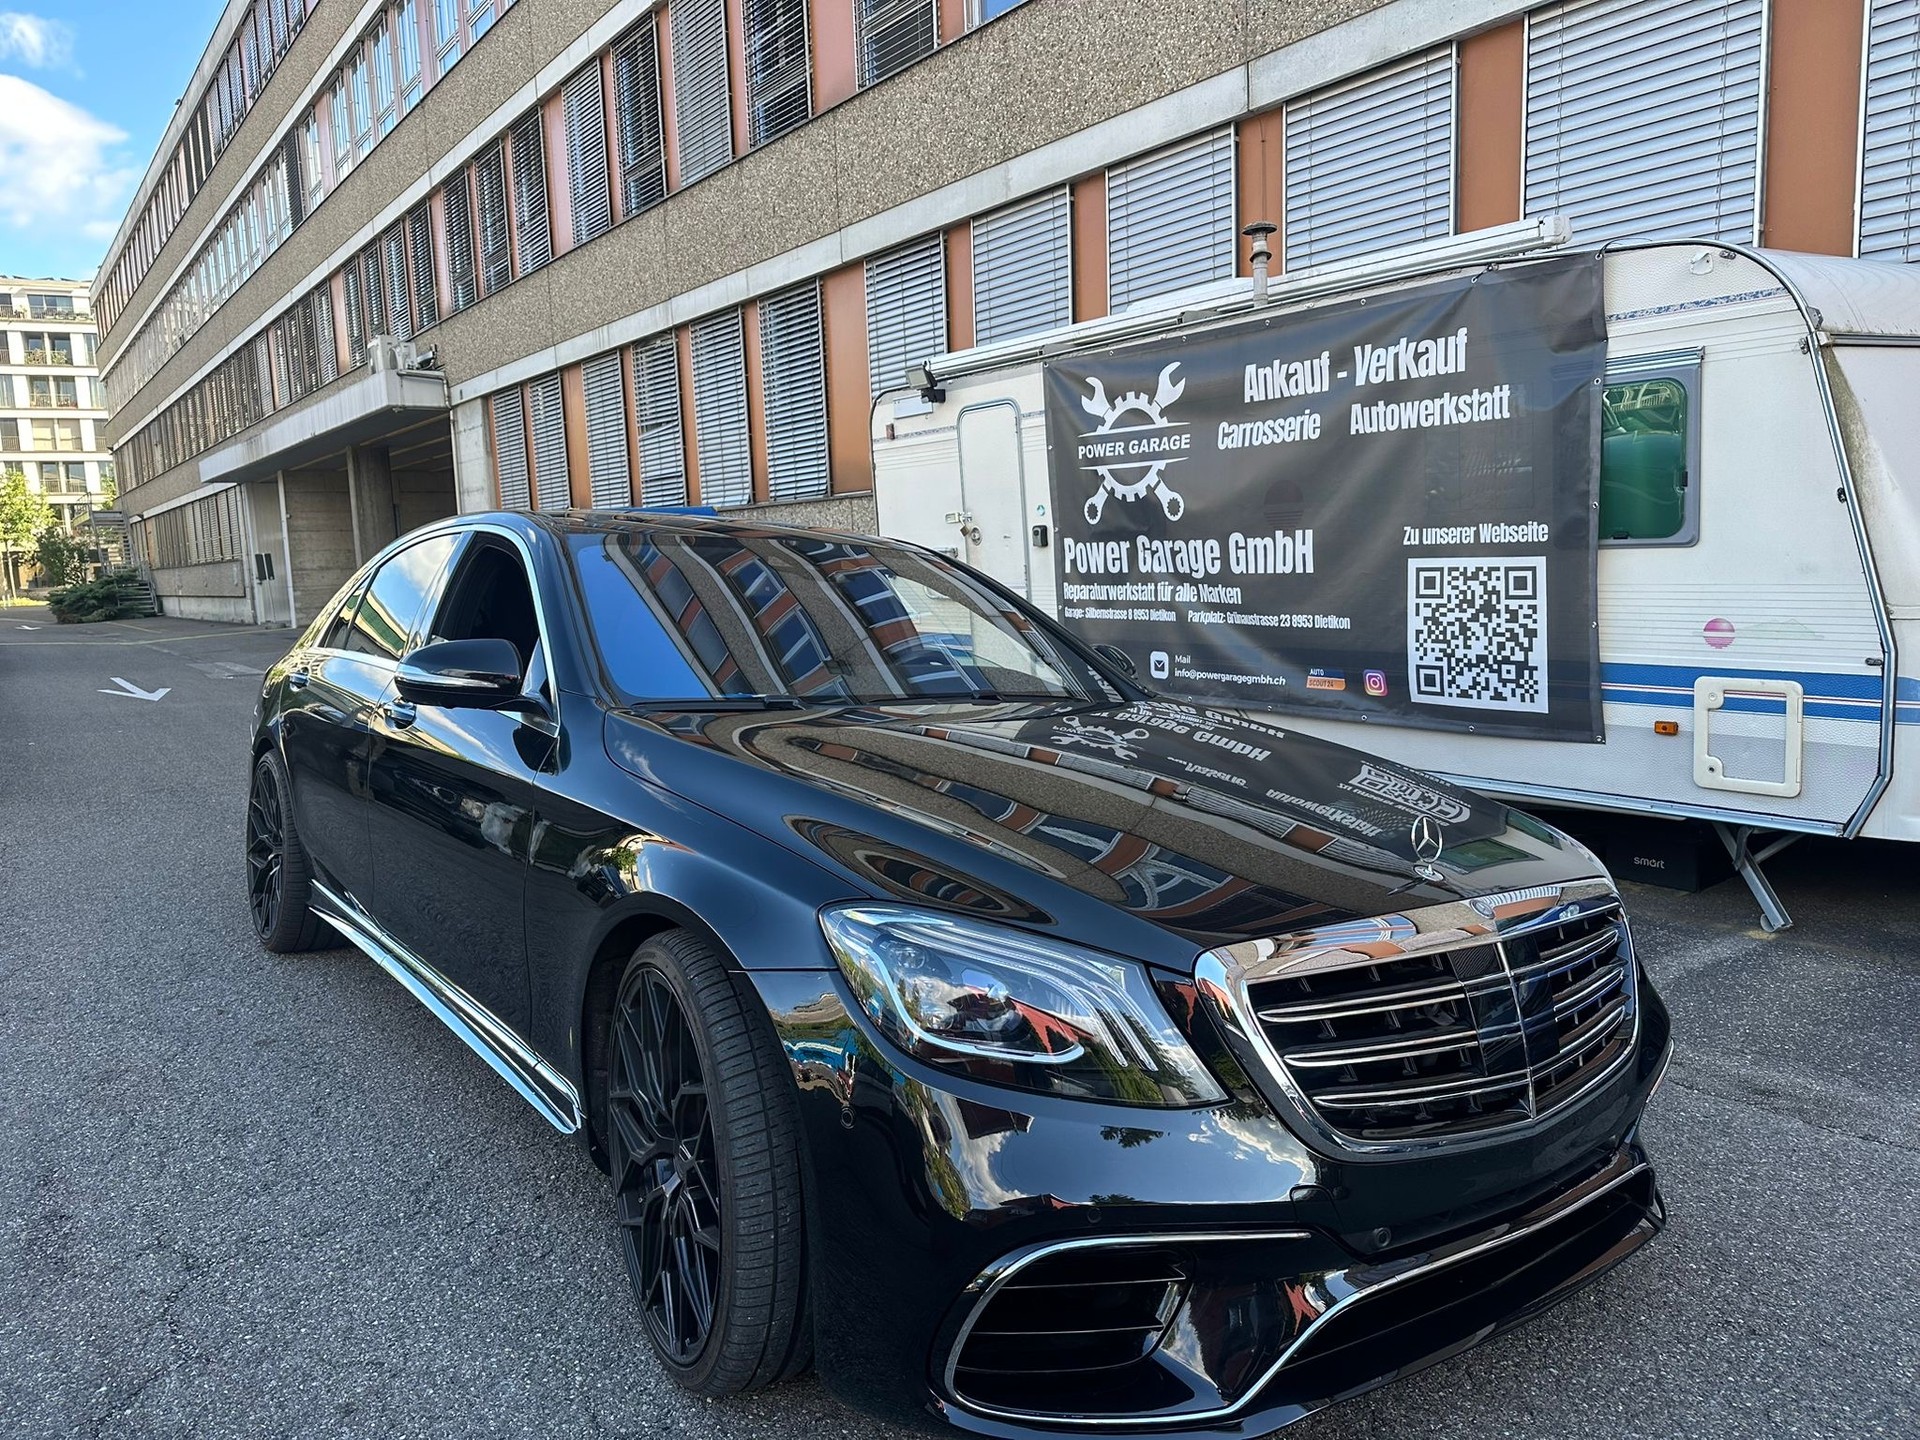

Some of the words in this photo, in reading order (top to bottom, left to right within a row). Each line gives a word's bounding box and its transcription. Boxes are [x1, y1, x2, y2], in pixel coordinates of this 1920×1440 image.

[1244, 350, 1330, 404] Ankauf
[1353, 327, 1468, 387] Verkauf
[1217, 409, 1321, 450] Carrosserie
[1350, 384, 1511, 435] Autowerkstatt
[1078, 440, 1124, 459] POWER
[1128, 433, 1191, 455] GARAGE
[1402, 526, 1420, 546] Zu
[1422, 525, 1477, 545] unserer
[1478, 520, 1549, 544] Webseite
[1063, 537, 1130, 574] Power
[1136, 534, 1221, 579] Garage
[1228, 529, 1314, 574] GmbH
[1063, 582, 1156, 602] Reparaturwerkstatt
[1157, 581, 1174, 602] für
[1175, 583, 1198, 603] alle
[1198, 584, 1242, 605] Marken
[1128, 609, 1133, 620] 8
[1134, 609, 1149, 621] 8953
[1150, 610, 1177, 622] Dietikon
[1187, 610, 1226, 625] Parkplatz:
[1226, 611, 1279, 627] Grünaustrasse
[1280, 614, 1291, 627] 23
[1292, 614, 1313, 628] 8953
[1314, 615, 1351, 630] Dietikon
[1174, 655, 1191, 664] Mail
[1174, 667, 1286, 686] info@powergaragegmbh.ch
[1309, 668, 1325, 676] AUTO
[1308, 678, 1334, 688] SCOUT24
[1633, 856, 1665, 869] smart
